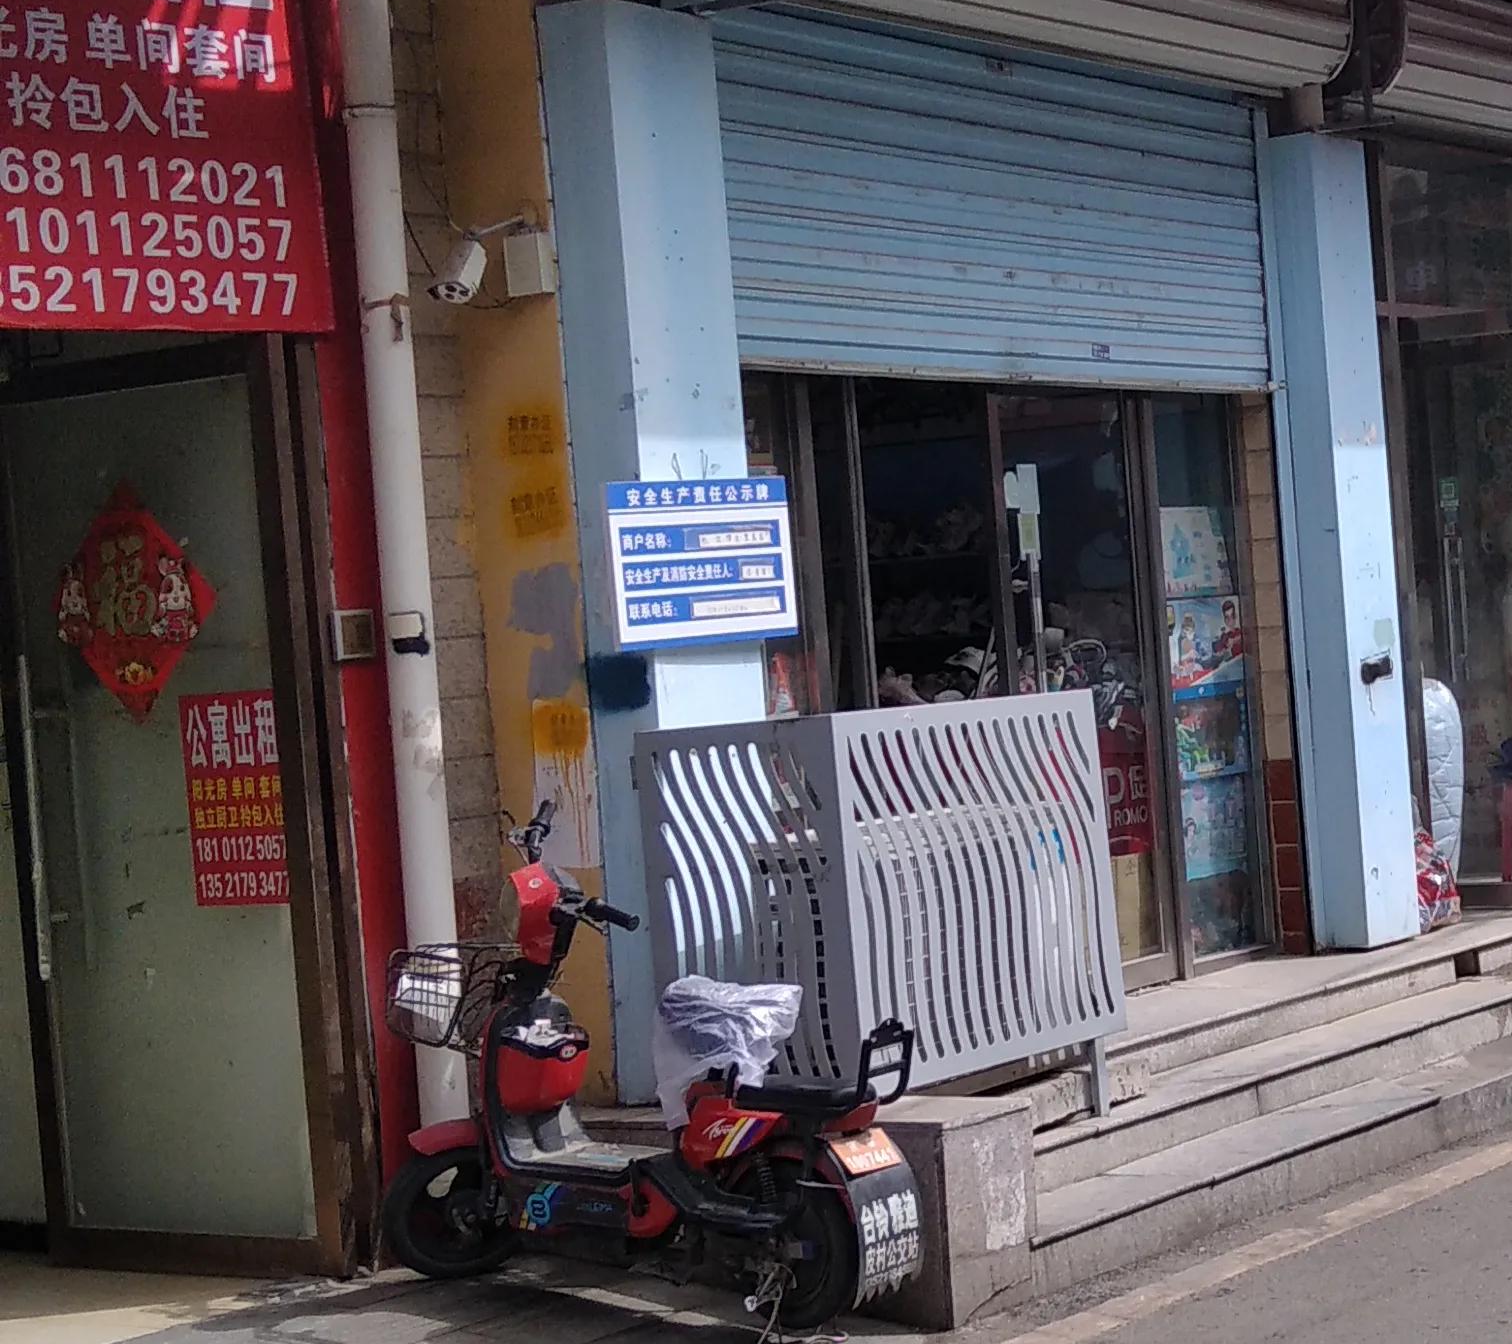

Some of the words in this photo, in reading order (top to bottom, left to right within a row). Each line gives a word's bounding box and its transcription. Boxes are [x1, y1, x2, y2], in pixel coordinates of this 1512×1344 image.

[86, 13, 276, 83] 单间套间
[6, 71, 209, 140] 拎包入住
[0, 147, 287, 208] 681112021
[6, 207, 292, 261] 101125057
[0, 265, 298, 317] 521793477
[626, 484, 769, 507] 安全生产责任公示牌
[187, 698, 279, 769] 公寓出租
[196, 837, 219, 863] 181
[222, 836, 255, 862] 0112
[200, 873, 223, 898] 135
[225, 872, 257, 898] 2179
